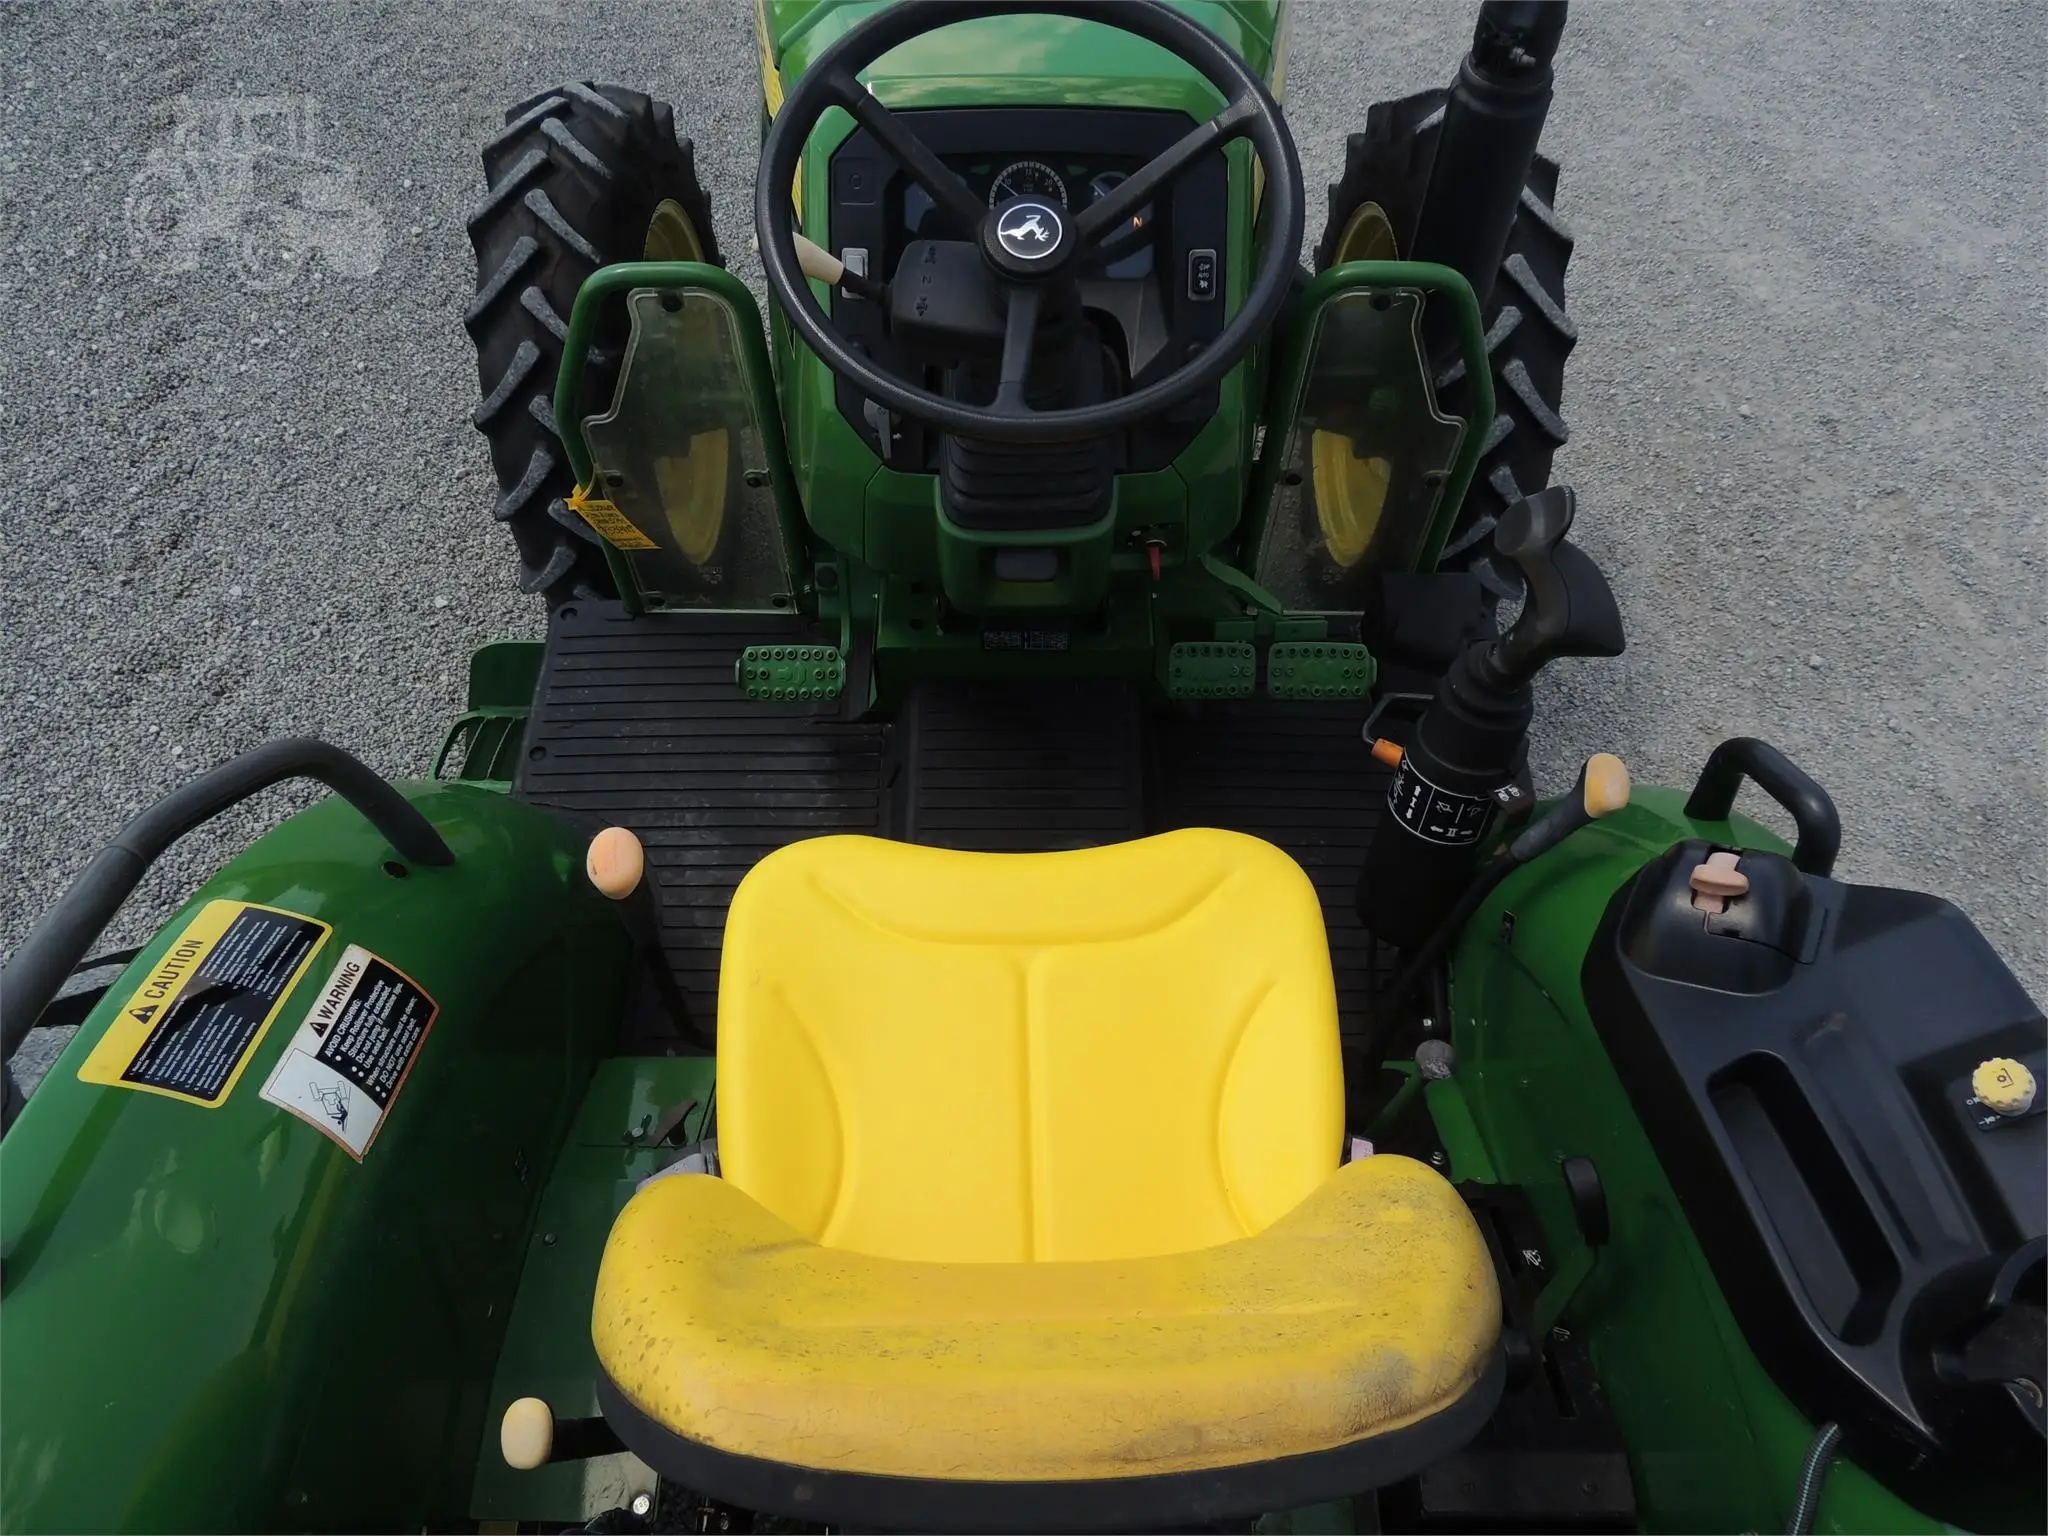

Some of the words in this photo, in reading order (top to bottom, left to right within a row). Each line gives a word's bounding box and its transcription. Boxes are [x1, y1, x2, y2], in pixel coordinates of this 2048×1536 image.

[1133, 216, 1142, 228] N
[143, 935, 204, 1000] CAUTION
[317, 959, 360, 1023] WARNING
[324, 1033, 341, 1057] AVOID
[336, 996, 362, 1035] CRUSHING:
[339, 1033, 355, 1053] Keep
[349, 1007, 368, 1035] Rollover
[363, 978, 385, 1009] Protective
[347, 1025, 369, 1058] Structure
[364, 1012, 377, 1029] fully
[355, 1051, 365, 1063] Do
[361, 1039, 372, 1053] not
[367, 1023, 382, 1042] jump
[378, 993, 397, 1020] machine
[362, 1053, 374, 1069] Use
[370, 1039, 382, 1055] seat
[378, 1025, 390, 1041] belt.
[365, 1065, 381, 1086] When
[376, 1036, 396, 1067] structure
[391, 1021, 404, 1038] must
[399, 1012, 408, 1023] be
[379, 1070, 389, 1083] DO
[385, 1054, 397, 1071] NOT
[394, 1043, 403, 1056] use
[399, 1029, 410, 1044] seat
[385, 1070, 398, 1089] Drive
